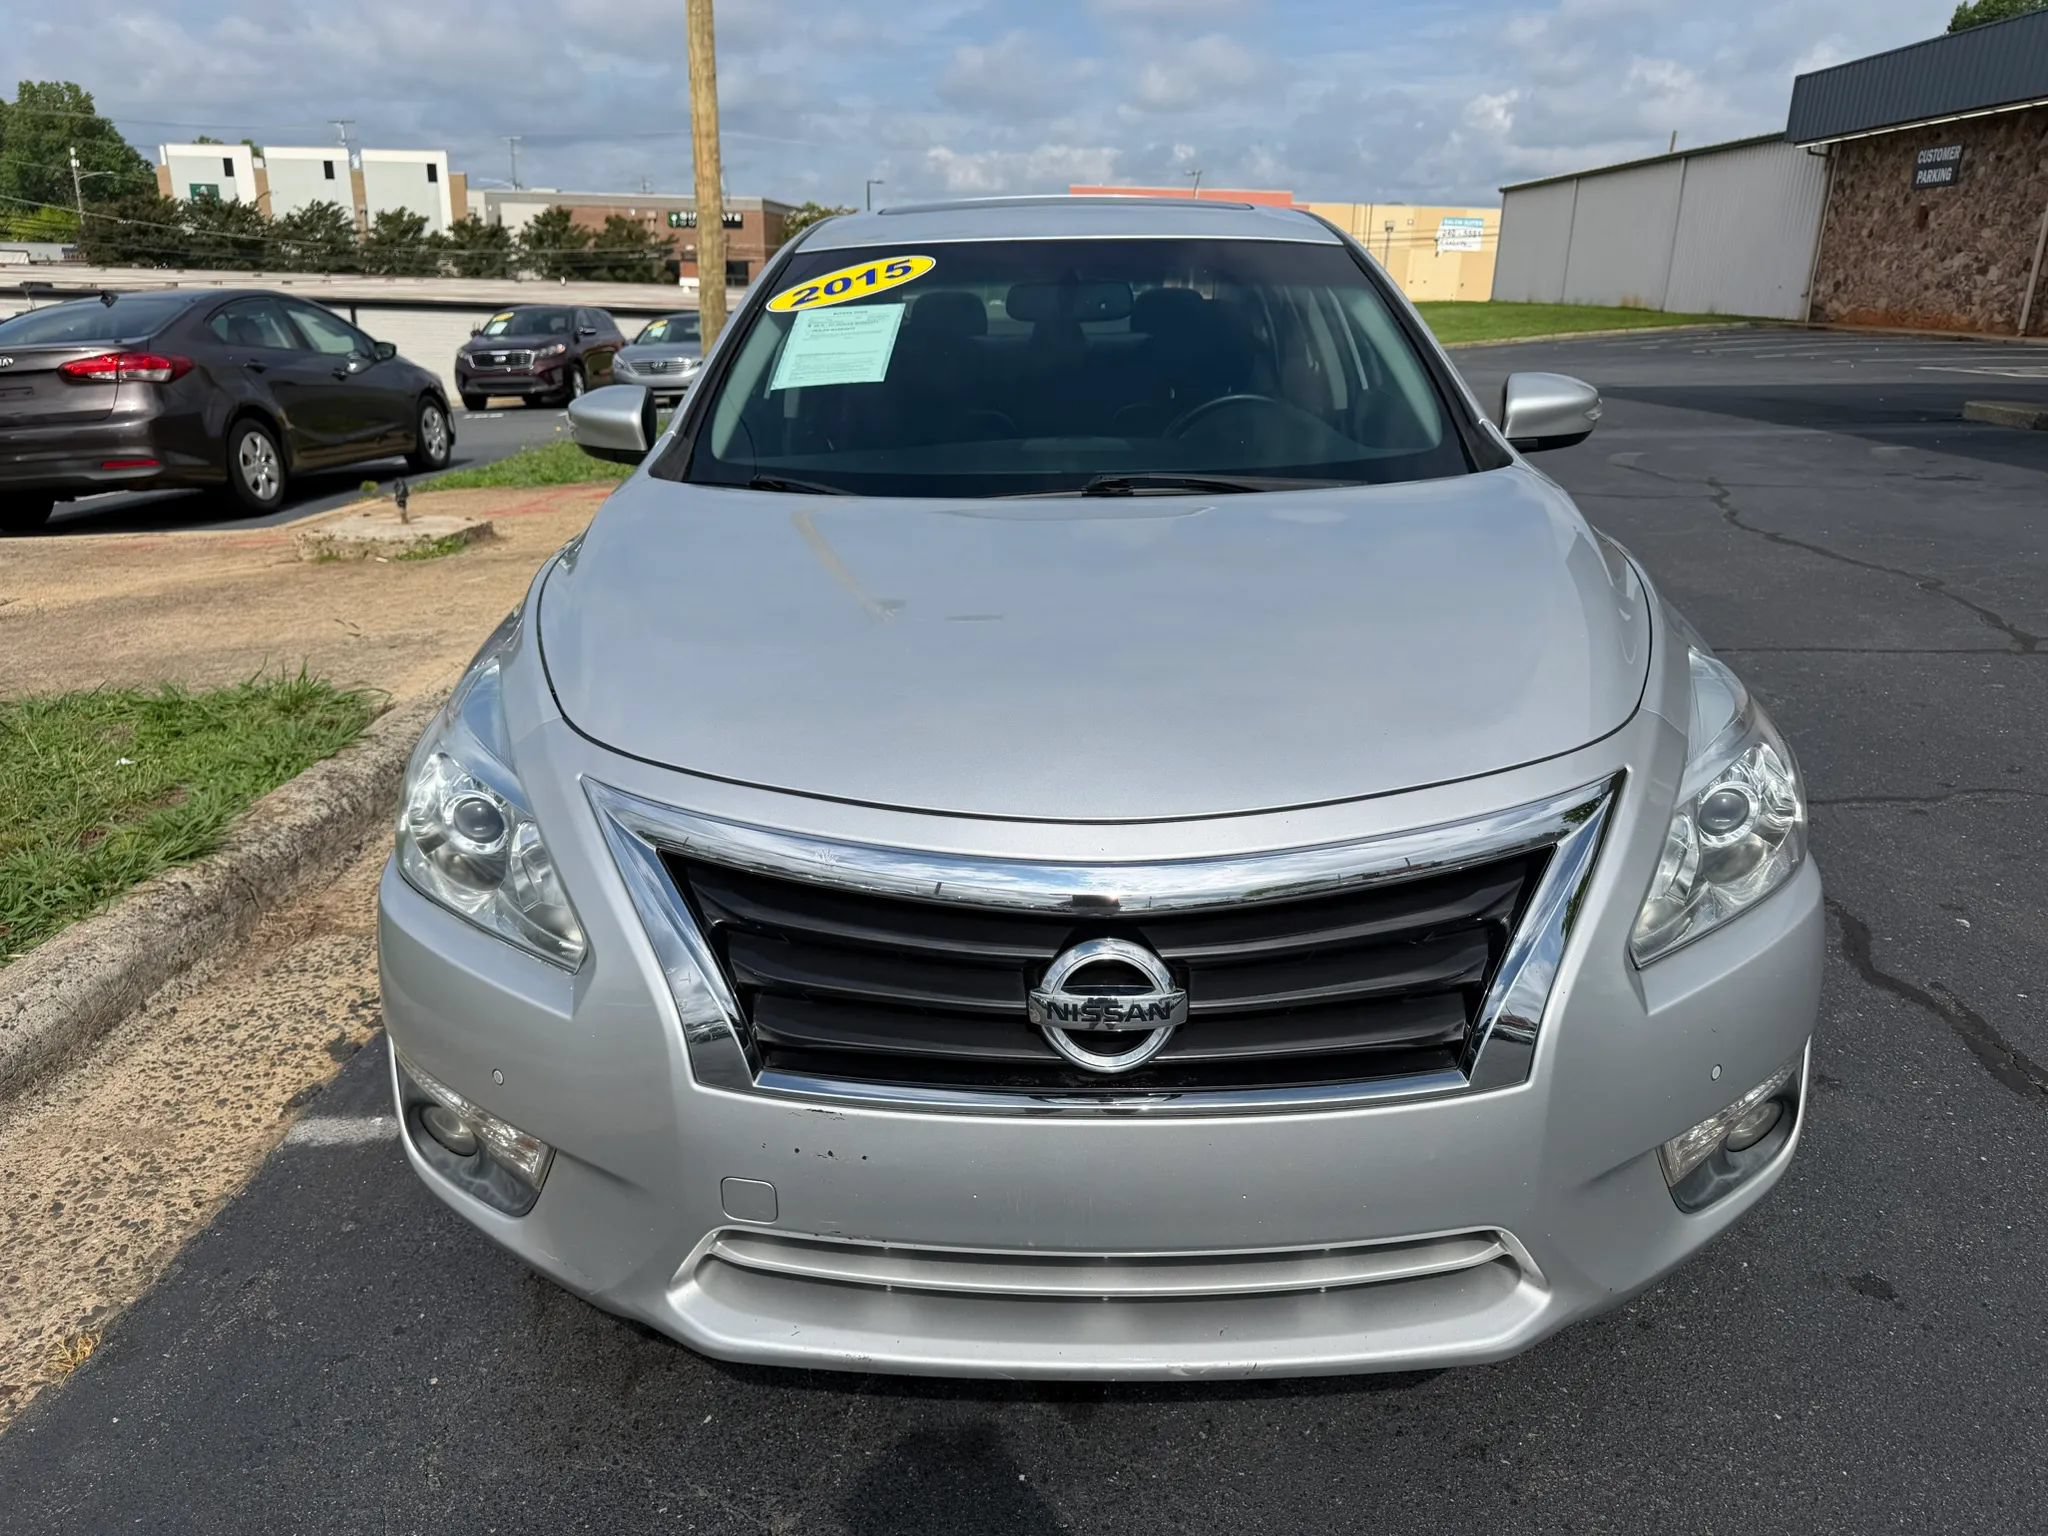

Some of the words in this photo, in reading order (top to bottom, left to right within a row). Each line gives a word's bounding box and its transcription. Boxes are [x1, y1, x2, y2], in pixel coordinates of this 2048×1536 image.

[1917, 145, 1962, 164] CUSTOMER
[1916, 167, 1952, 184] PARKING
[790, 259, 912, 307] 2015
[1046, 1001, 1171, 1023] NISSAN
